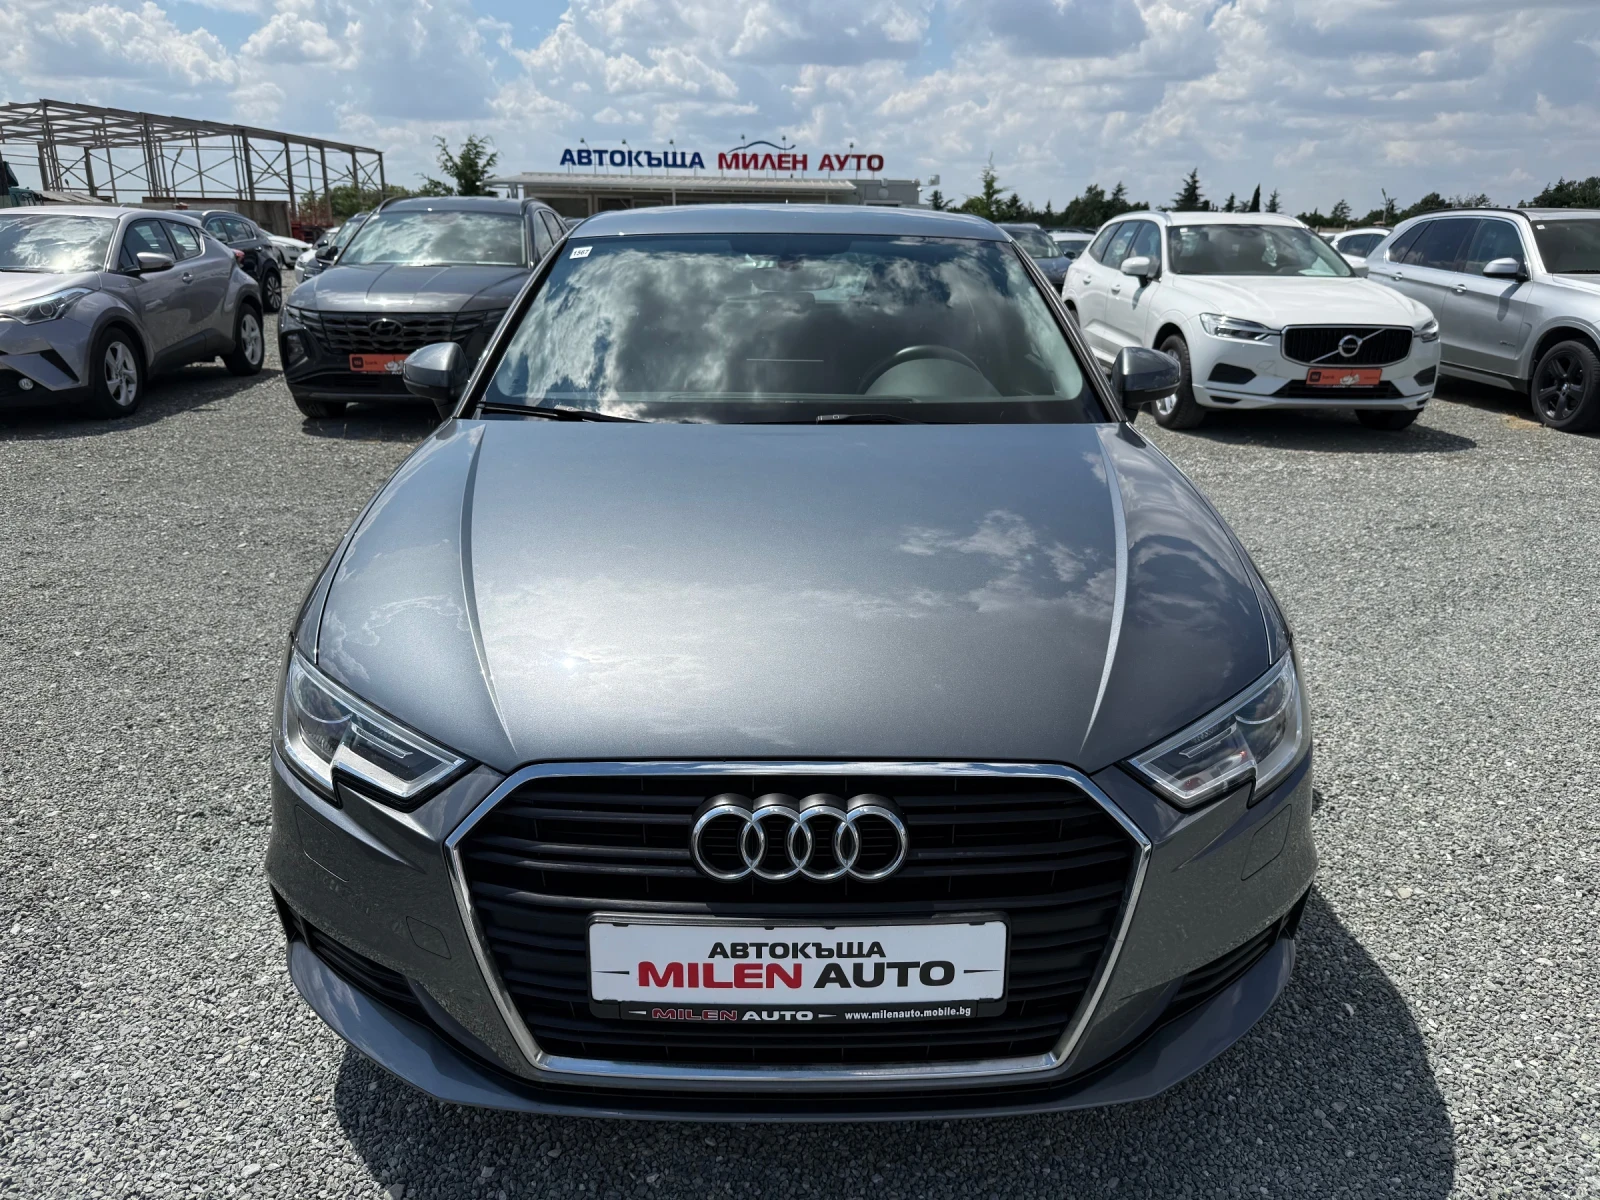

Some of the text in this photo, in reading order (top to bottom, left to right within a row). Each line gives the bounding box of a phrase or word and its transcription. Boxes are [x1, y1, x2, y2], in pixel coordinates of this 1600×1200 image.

[718, 152, 807, 171] МИЛЕН
[818, 154, 884, 172] АУТО
[637, 960, 955, 989] MILEN AUTO
[652, 1006, 971, 1021] MILEN AUTO www.milenauto.mobile.bg
